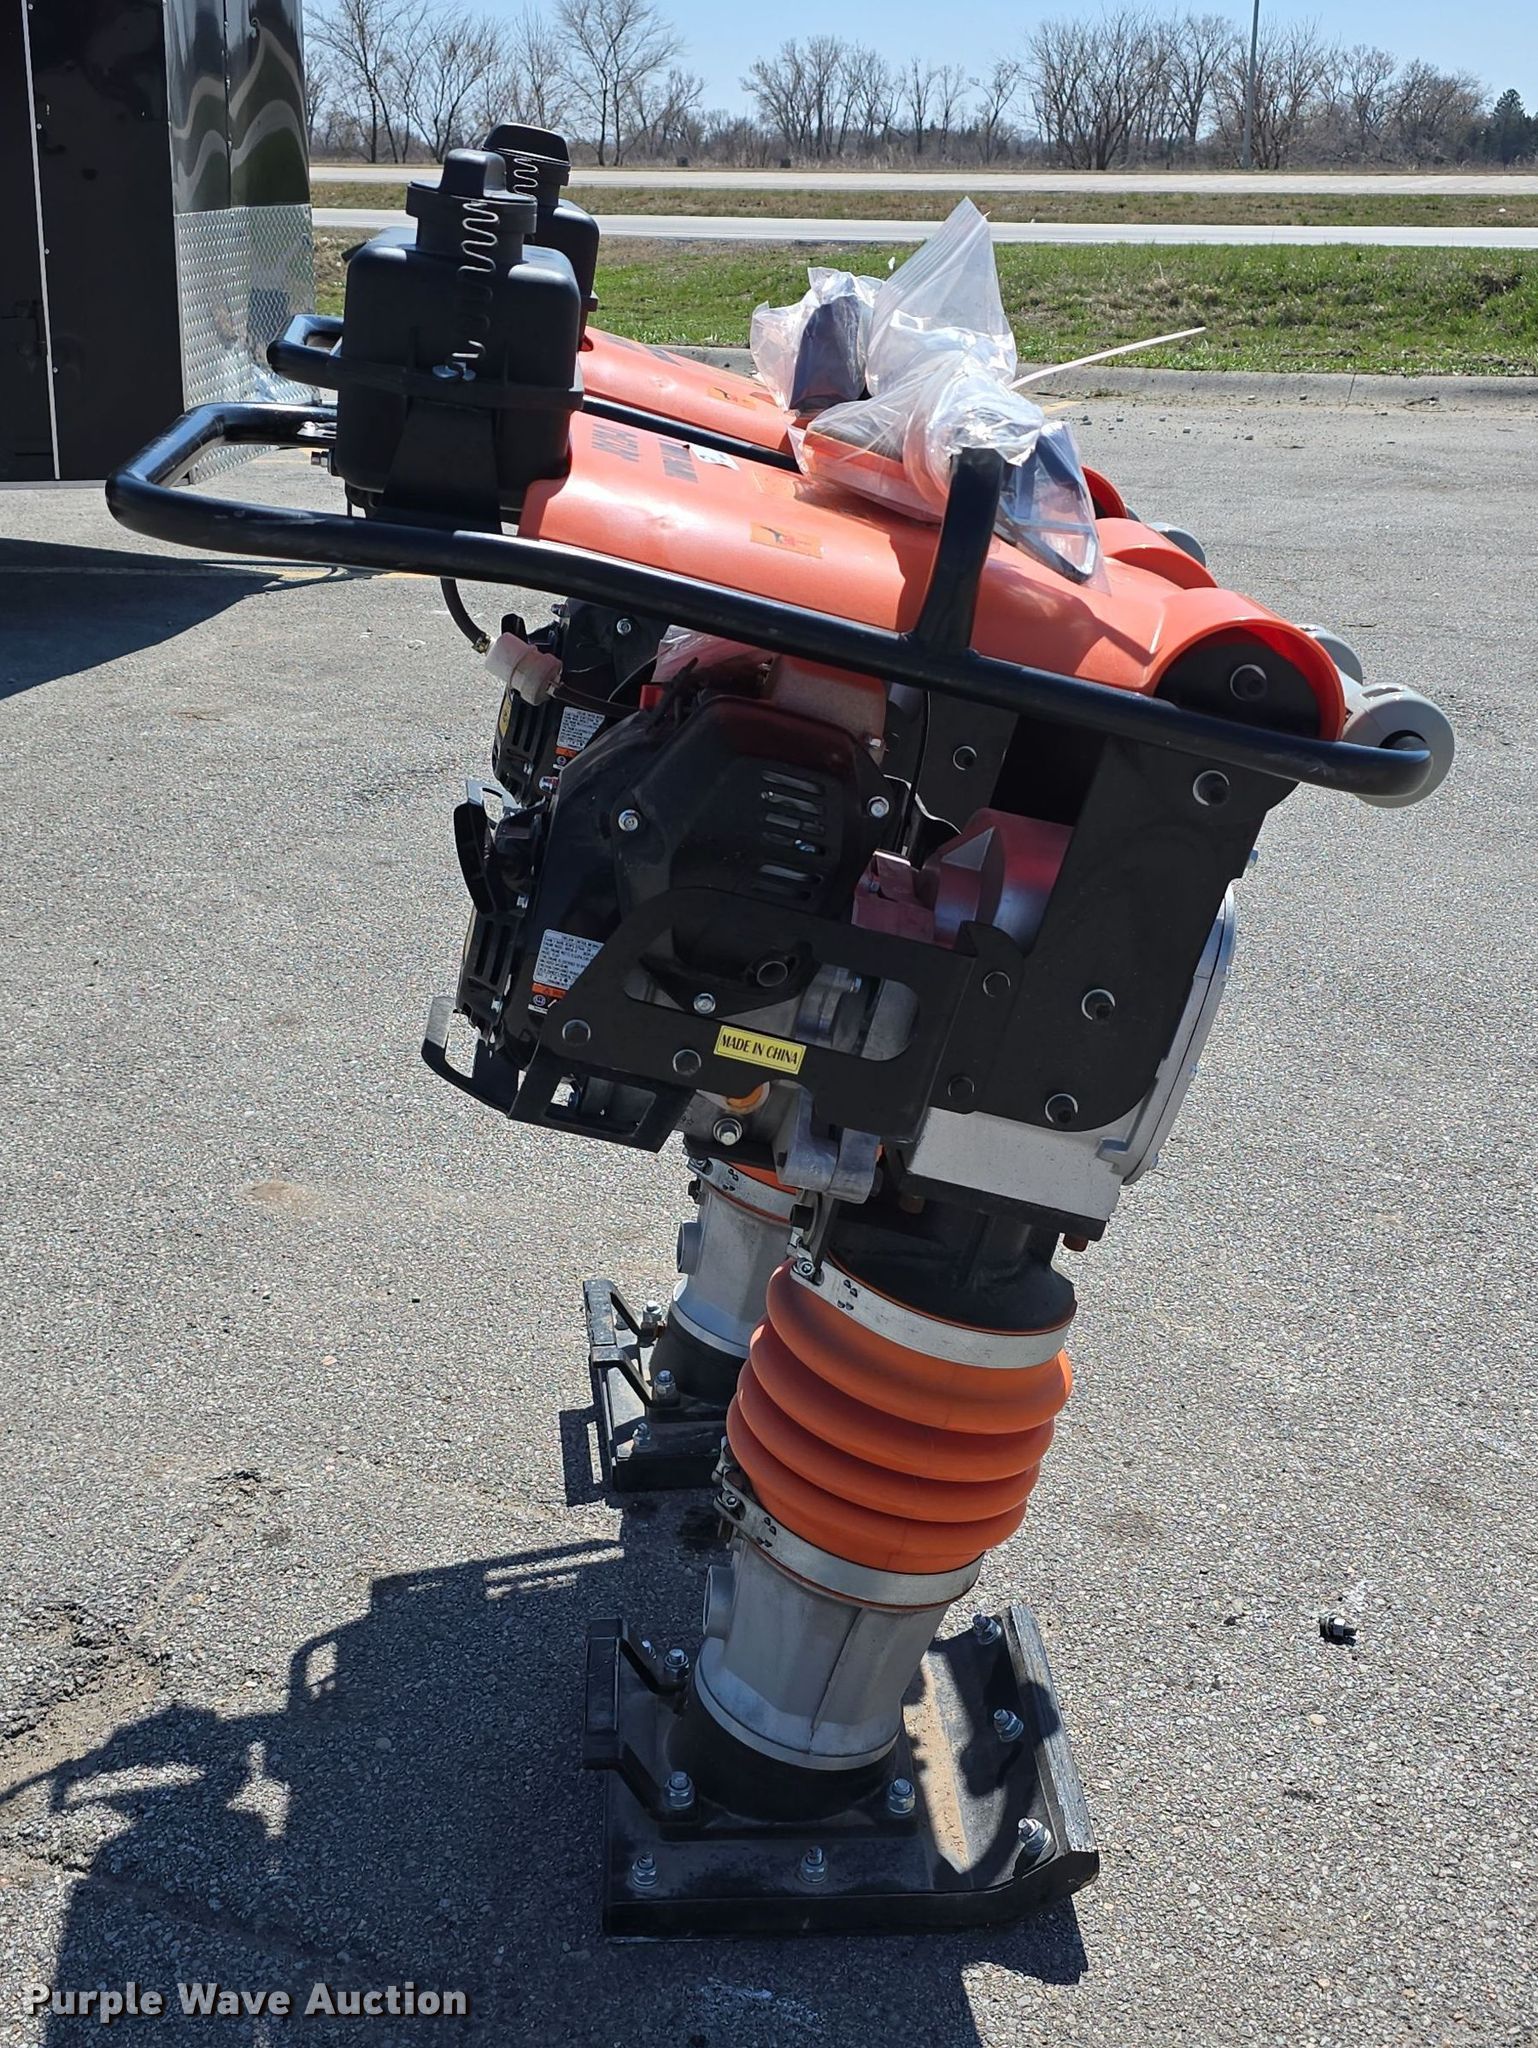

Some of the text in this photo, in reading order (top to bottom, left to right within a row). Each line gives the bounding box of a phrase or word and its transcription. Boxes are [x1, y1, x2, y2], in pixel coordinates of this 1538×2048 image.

[720, 1034, 798, 1065] MADE IN CHINA
